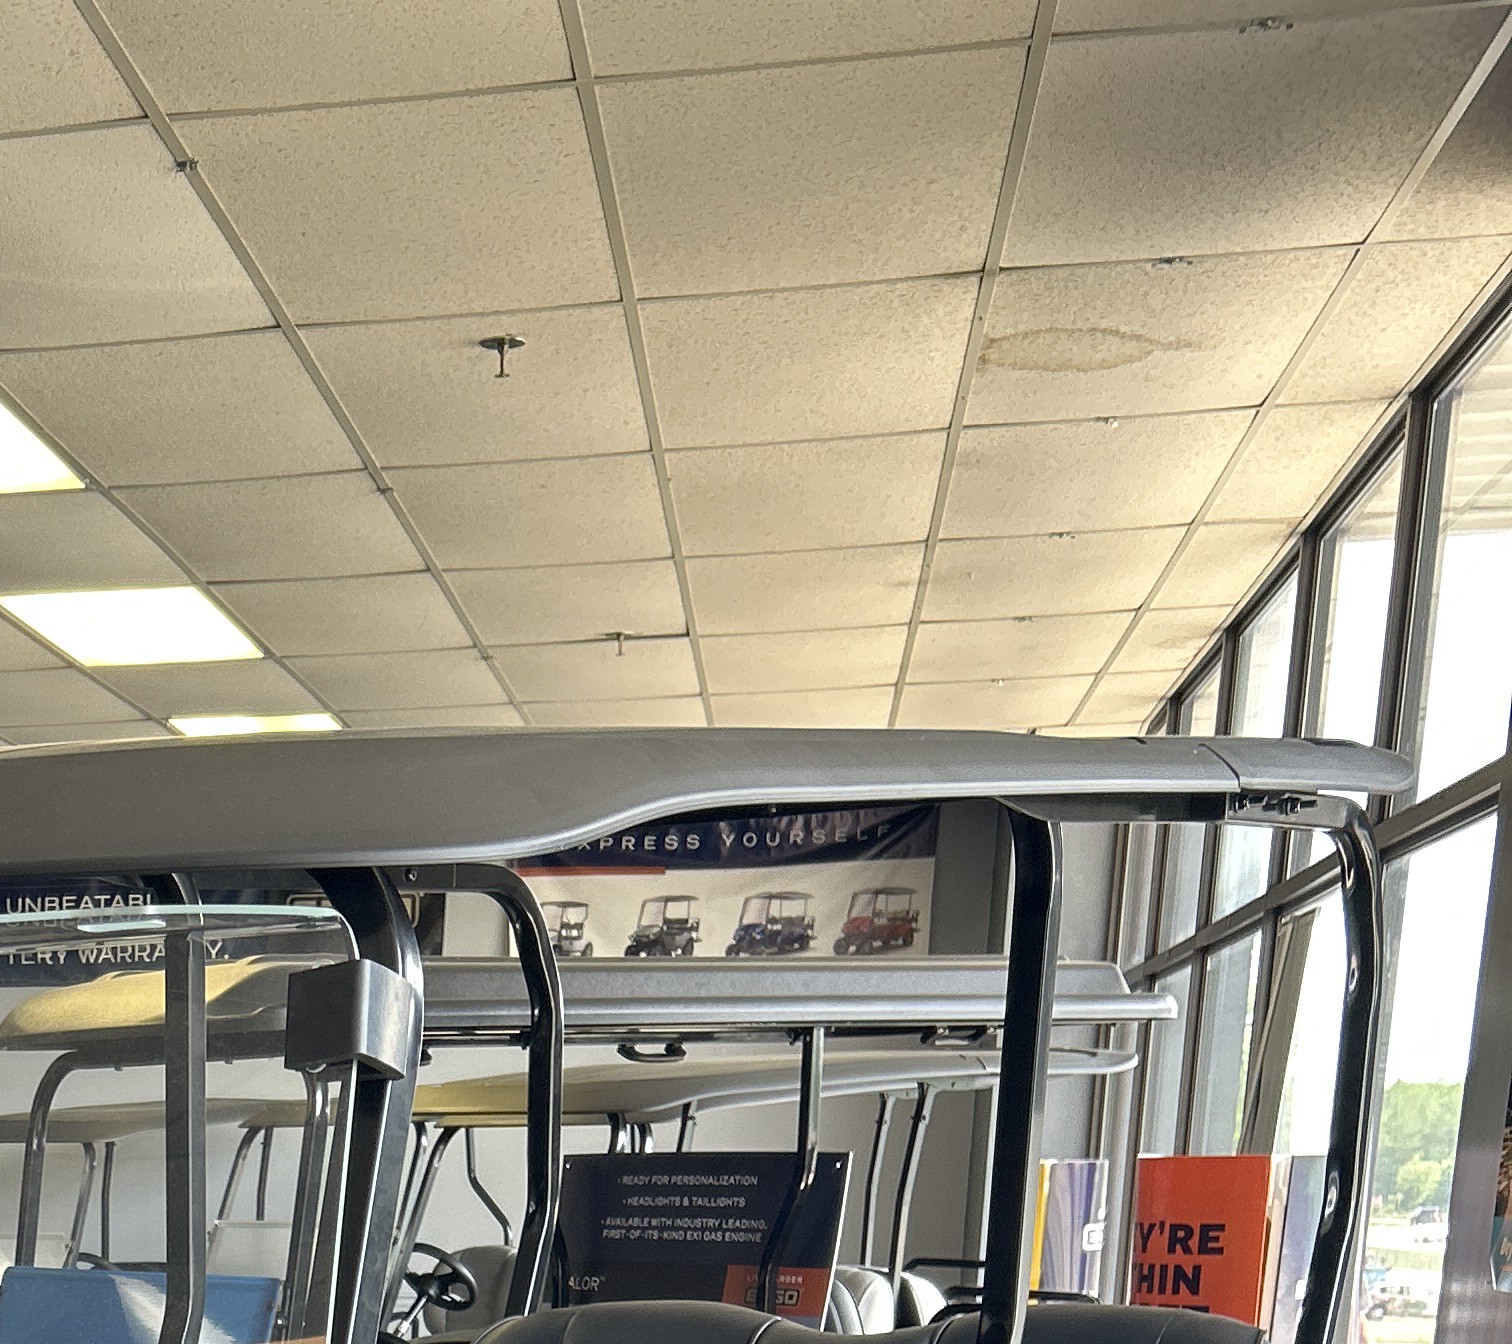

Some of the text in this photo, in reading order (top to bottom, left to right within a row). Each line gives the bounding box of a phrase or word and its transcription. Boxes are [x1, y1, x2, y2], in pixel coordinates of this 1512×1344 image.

[576, 825, 890, 851] XPRESS YOURSELF
[651, 1175, 669, 1186] FOR
[671, 1175, 758, 1186] PERSONALIZATION
[627, 1196, 681, 1207] HEADLIGHTS
[691, 1196, 746, 1208] TAILLIGHTS
[605, 1217, 649, 1228] AVAILABLE
[651, 1217, 672, 1228] WITH
[674, 1218, 721, 1229] INDUSTRY
[703, 1231, 723, 1242] GAS
[725, 1231, 763, 1243] ENGINE
